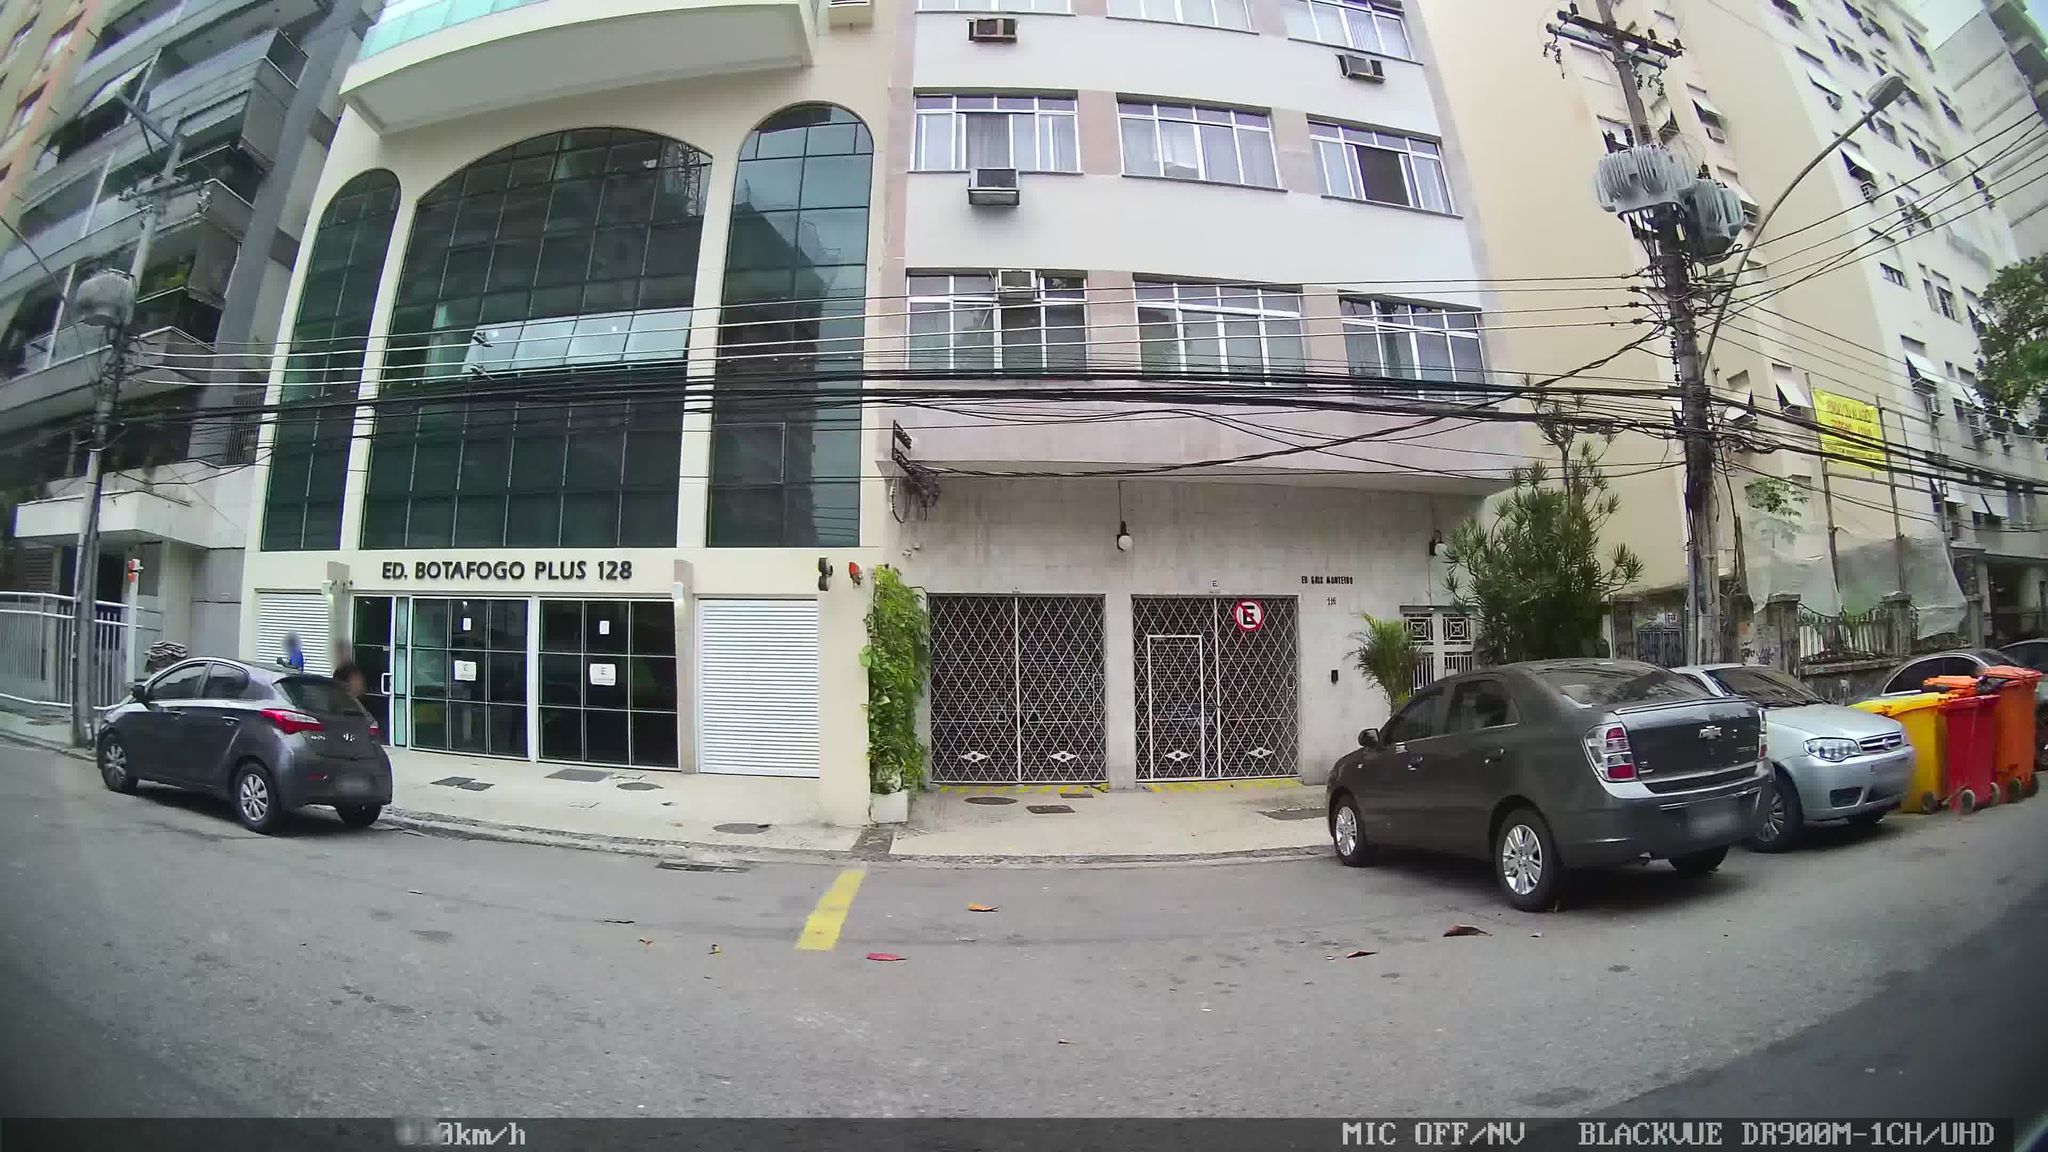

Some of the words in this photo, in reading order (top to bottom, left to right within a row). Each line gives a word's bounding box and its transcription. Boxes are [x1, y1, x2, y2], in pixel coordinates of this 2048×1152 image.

[381, 561, 408, 580] ED.
[414, 560, 525, 580] BOTAFOGO
[534, 561, 587, 580] PLUS
[597, 560, 633, 580] 128
